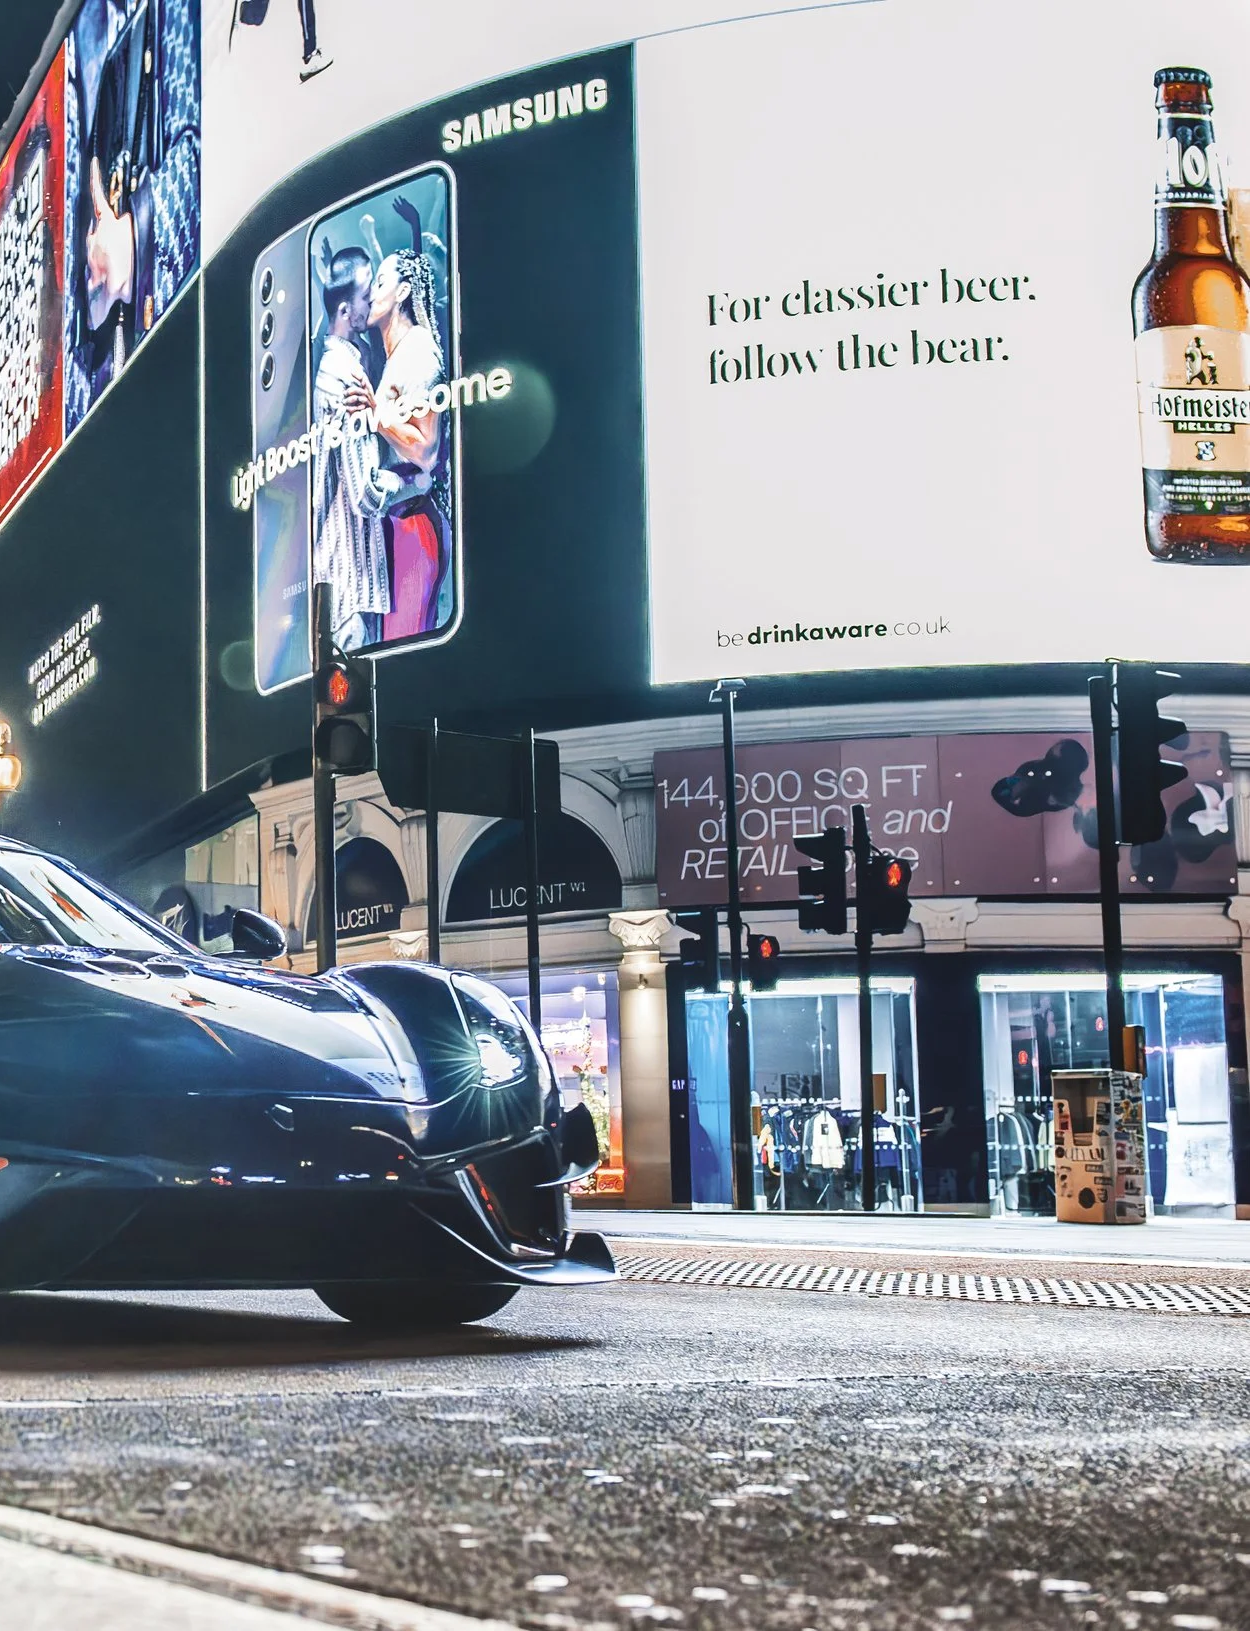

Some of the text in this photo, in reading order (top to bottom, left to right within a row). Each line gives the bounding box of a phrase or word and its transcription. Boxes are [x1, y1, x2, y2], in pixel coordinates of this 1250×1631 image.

[442, 78, 608, 153] SAMSUNG
[707, 292, 771, 326] For
[781, 273, 929, 317] classier
[709, 329, 1010, 385] follow the bear.
[1152, 393, 1250, 418] Hofmeiste
[265, 422, 319, 482] Boost
[349, 367, 513, 437] awesome
[1177, 421, 1232, 432] HELLES
[282, 580, 307, 600] SAMSU
[51, 639, 63, 663] THE
[64, 622, 80, 651] FULL
[56, 652, 75, 682] APRIL
[813, 766, 870, 801] SQ
[881, 764, 928, 798] FT
[699, 811, 727, 843] of
[882, 800, 953, 835] and
[680, 845, 798, 880] RETAIL
[490, 883, 566, 909] LUCNT
[335, 904, 382, 930] LUCENT
[672, 1079, 685, 1090] GAP
